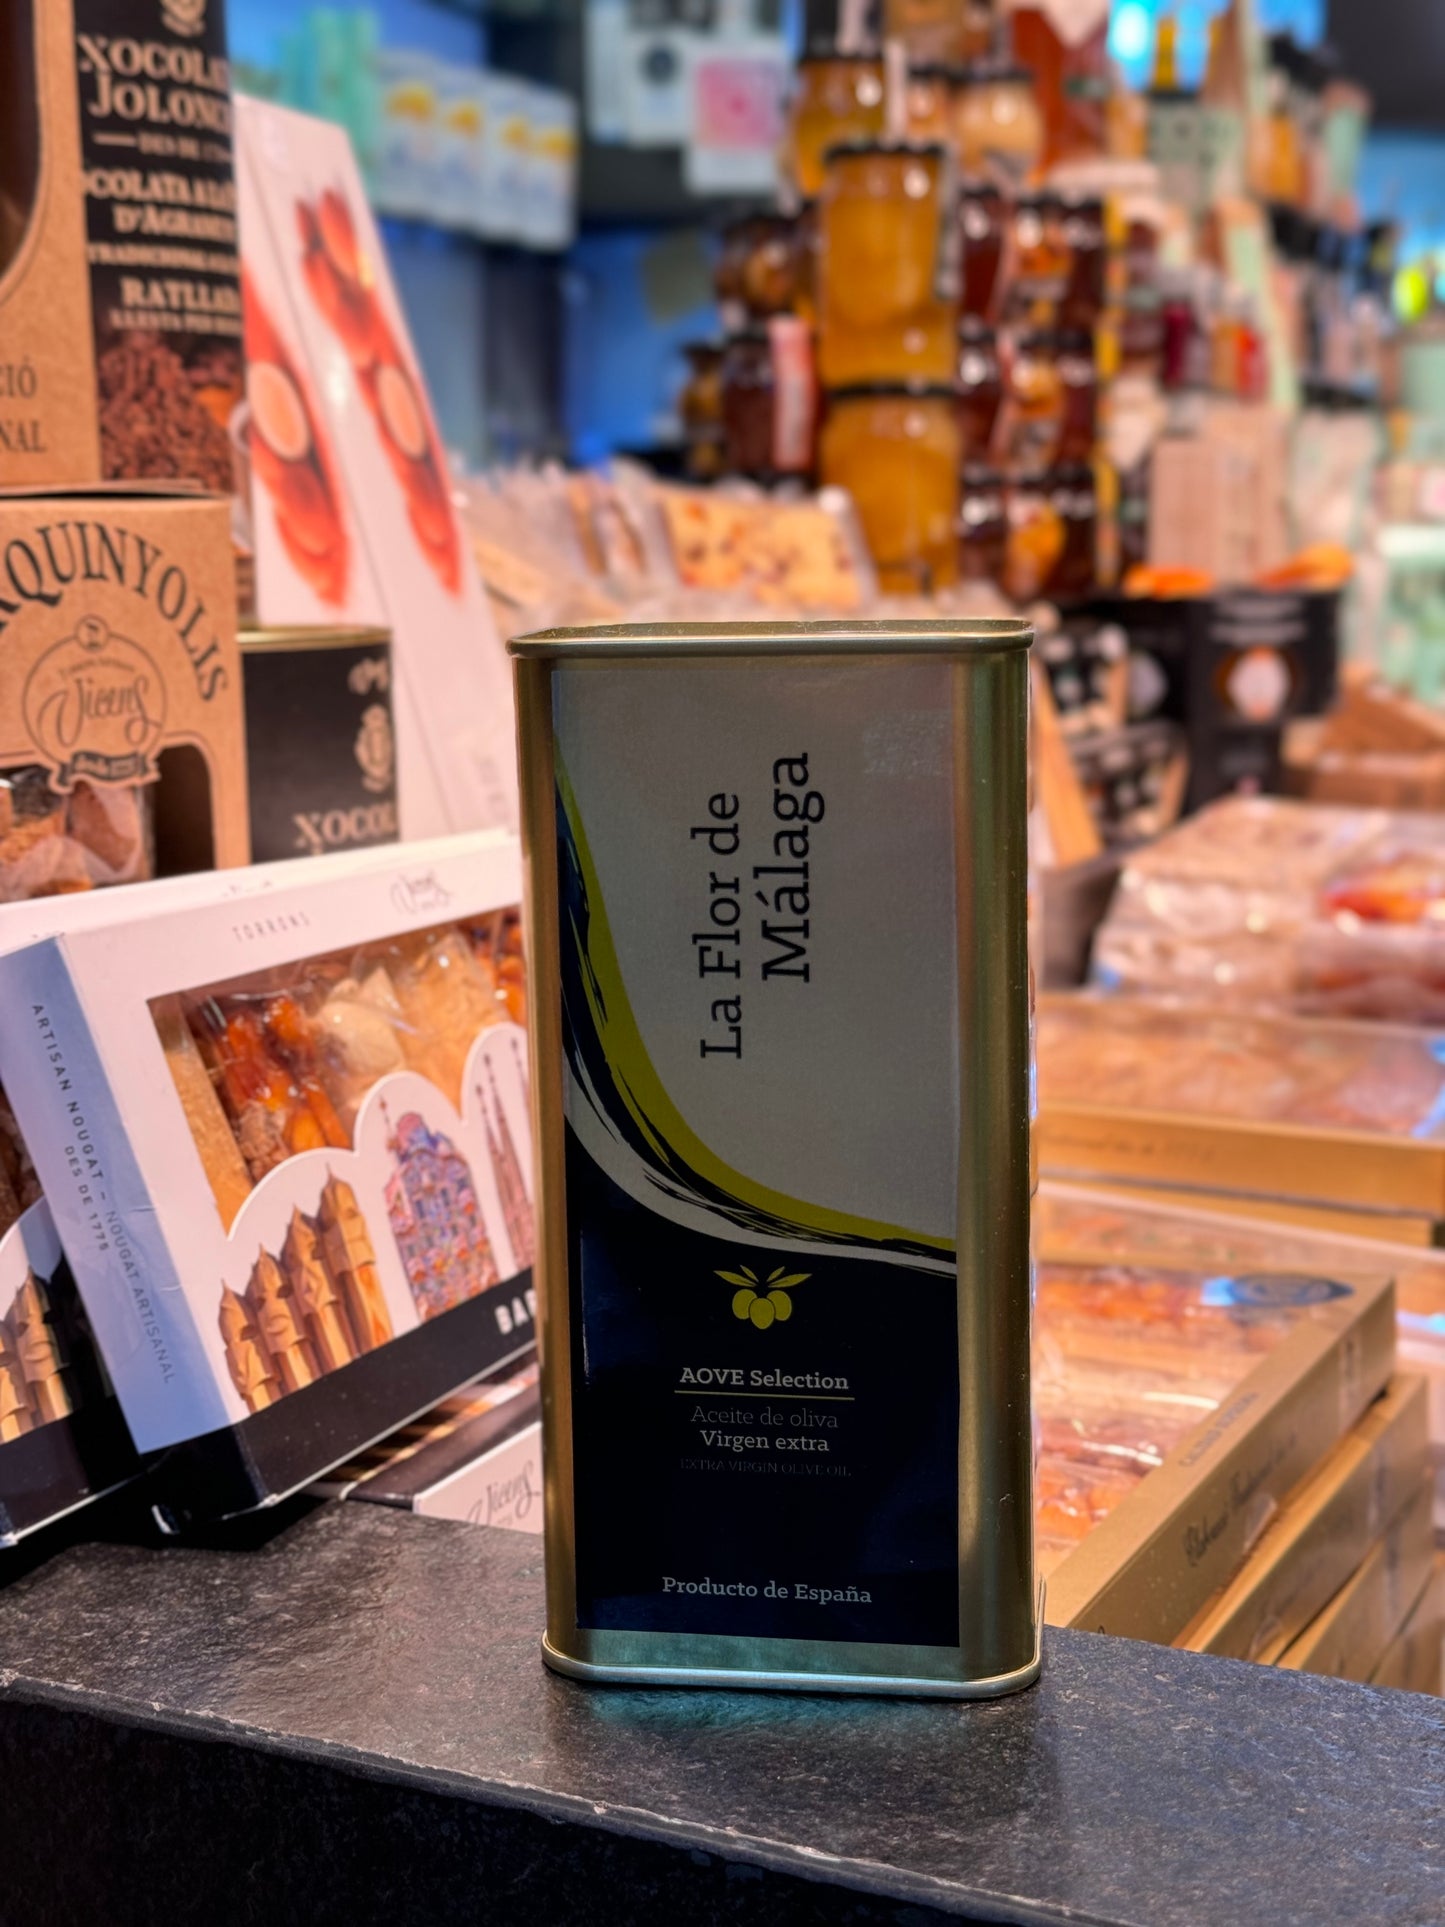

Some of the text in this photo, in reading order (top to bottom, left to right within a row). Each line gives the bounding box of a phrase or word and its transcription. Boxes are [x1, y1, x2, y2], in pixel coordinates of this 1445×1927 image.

[753, 752, 826, 984] Málaga
[690, 792, 742, 1060] La Flor de
[65, 1146, 83, 1178] DES
[78, 1185, 94, 1206] DE
[32, 1004, 72, 1092] ARTISAN
[67, 1101, 104, 1180] NOUGAT
[105, 1211, 140, 1280] NOUGAT
[132, 1287, 176, 1384] ARTISANAL
[679, 1367, 850, 1391] AOVE Selection
[690, 1405, 839, 1429] Aceite de oliva
[700, 1429, 831, 1453] Virgen extra
[680, 1457, 726, 1472] EXTRA
[728, 1459, 778, 1475] VIRGIN
[661, 1576, 873, 1606] Producto de España
